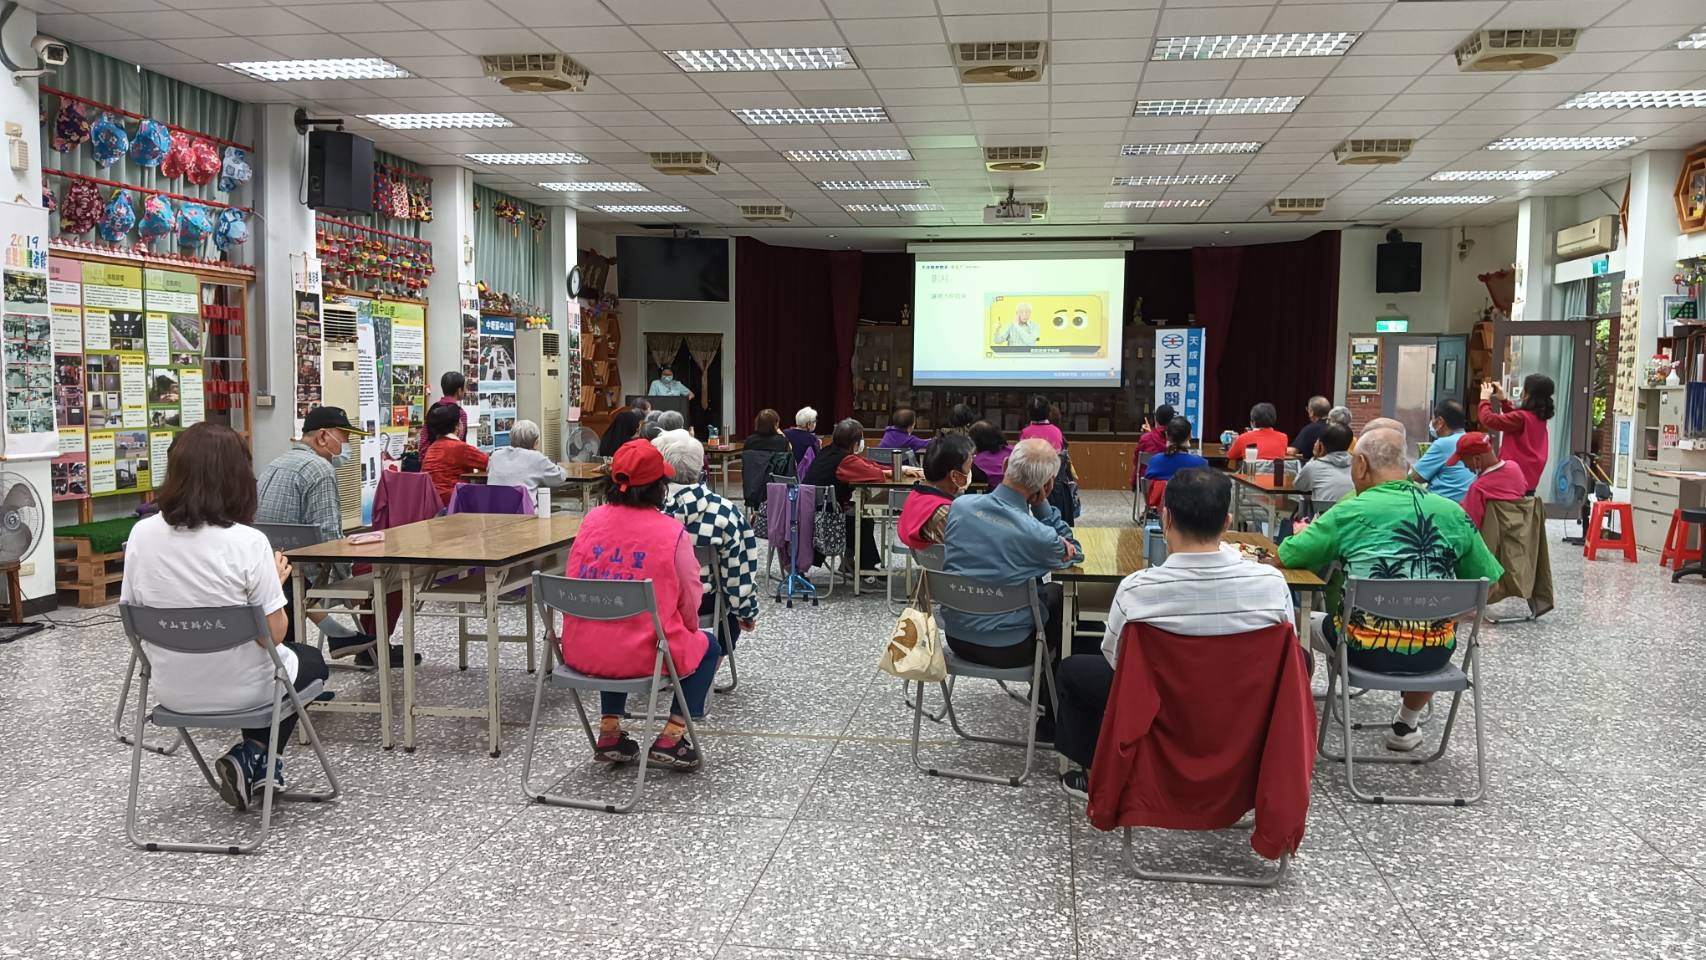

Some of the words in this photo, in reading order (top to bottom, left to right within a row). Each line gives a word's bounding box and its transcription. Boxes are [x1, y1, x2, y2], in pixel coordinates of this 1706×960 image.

[1164, 354, 1181, 416] 天晟醫
[592, 544, 646, 569] 中山里
